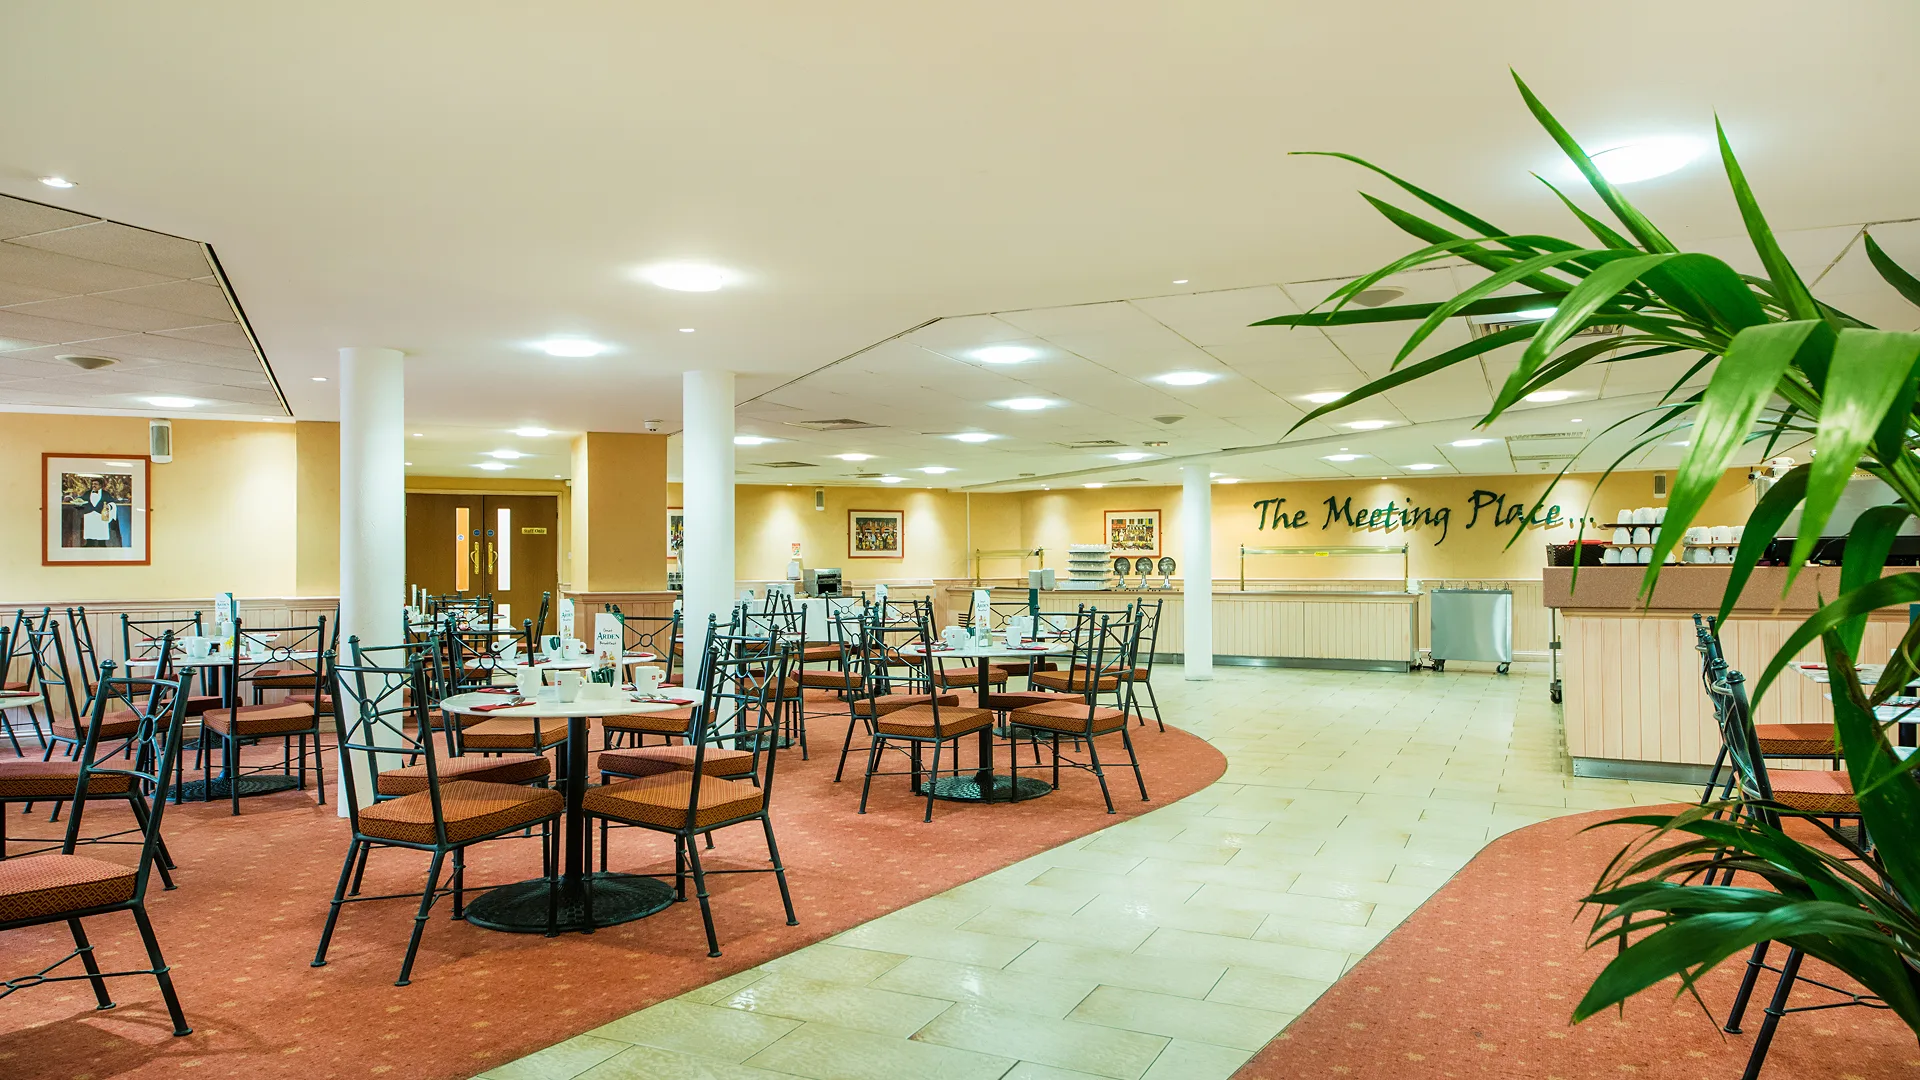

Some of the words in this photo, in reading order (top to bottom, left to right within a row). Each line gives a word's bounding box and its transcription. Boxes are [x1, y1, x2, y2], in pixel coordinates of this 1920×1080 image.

[1253, 497, 1308, 531] The
[1322, 495, 1451, 547] Meeting
[596, 632, 620, 640] ARDEN
